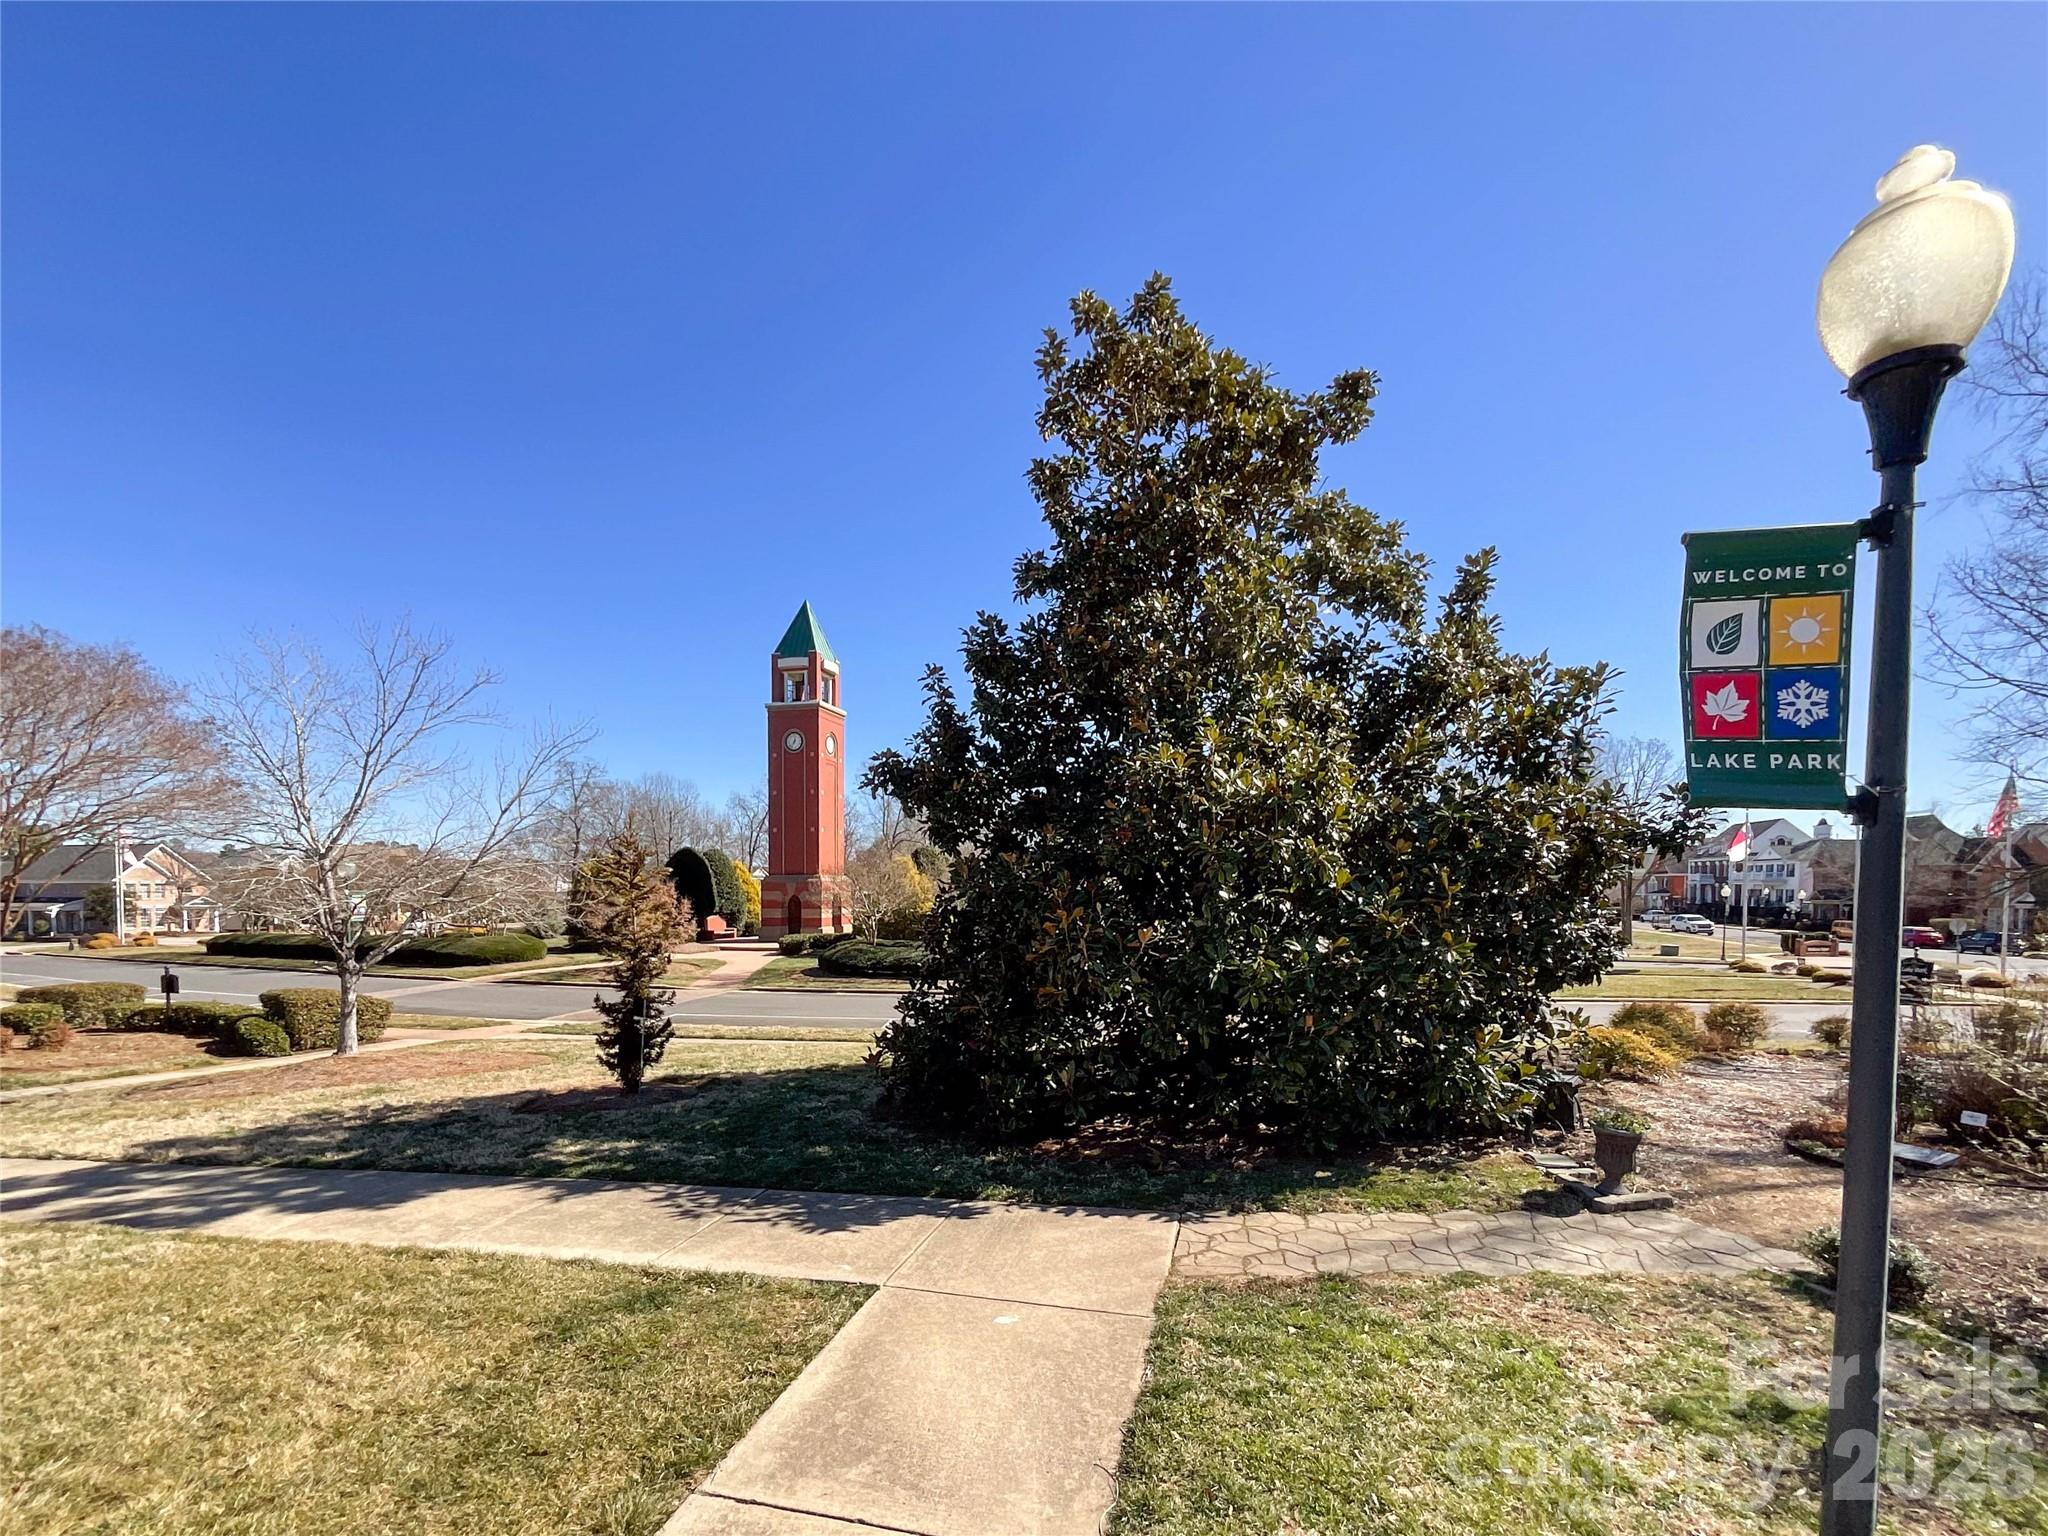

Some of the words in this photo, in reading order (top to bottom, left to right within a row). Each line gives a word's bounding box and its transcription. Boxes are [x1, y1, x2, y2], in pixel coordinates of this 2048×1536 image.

[1693, 565, 1806, 584] WELCOME
[1817, 563, 1848, 577] TO
[1690, 753, 1757, 769] LAKE
[1770, 753, 1841, 769] PARK
